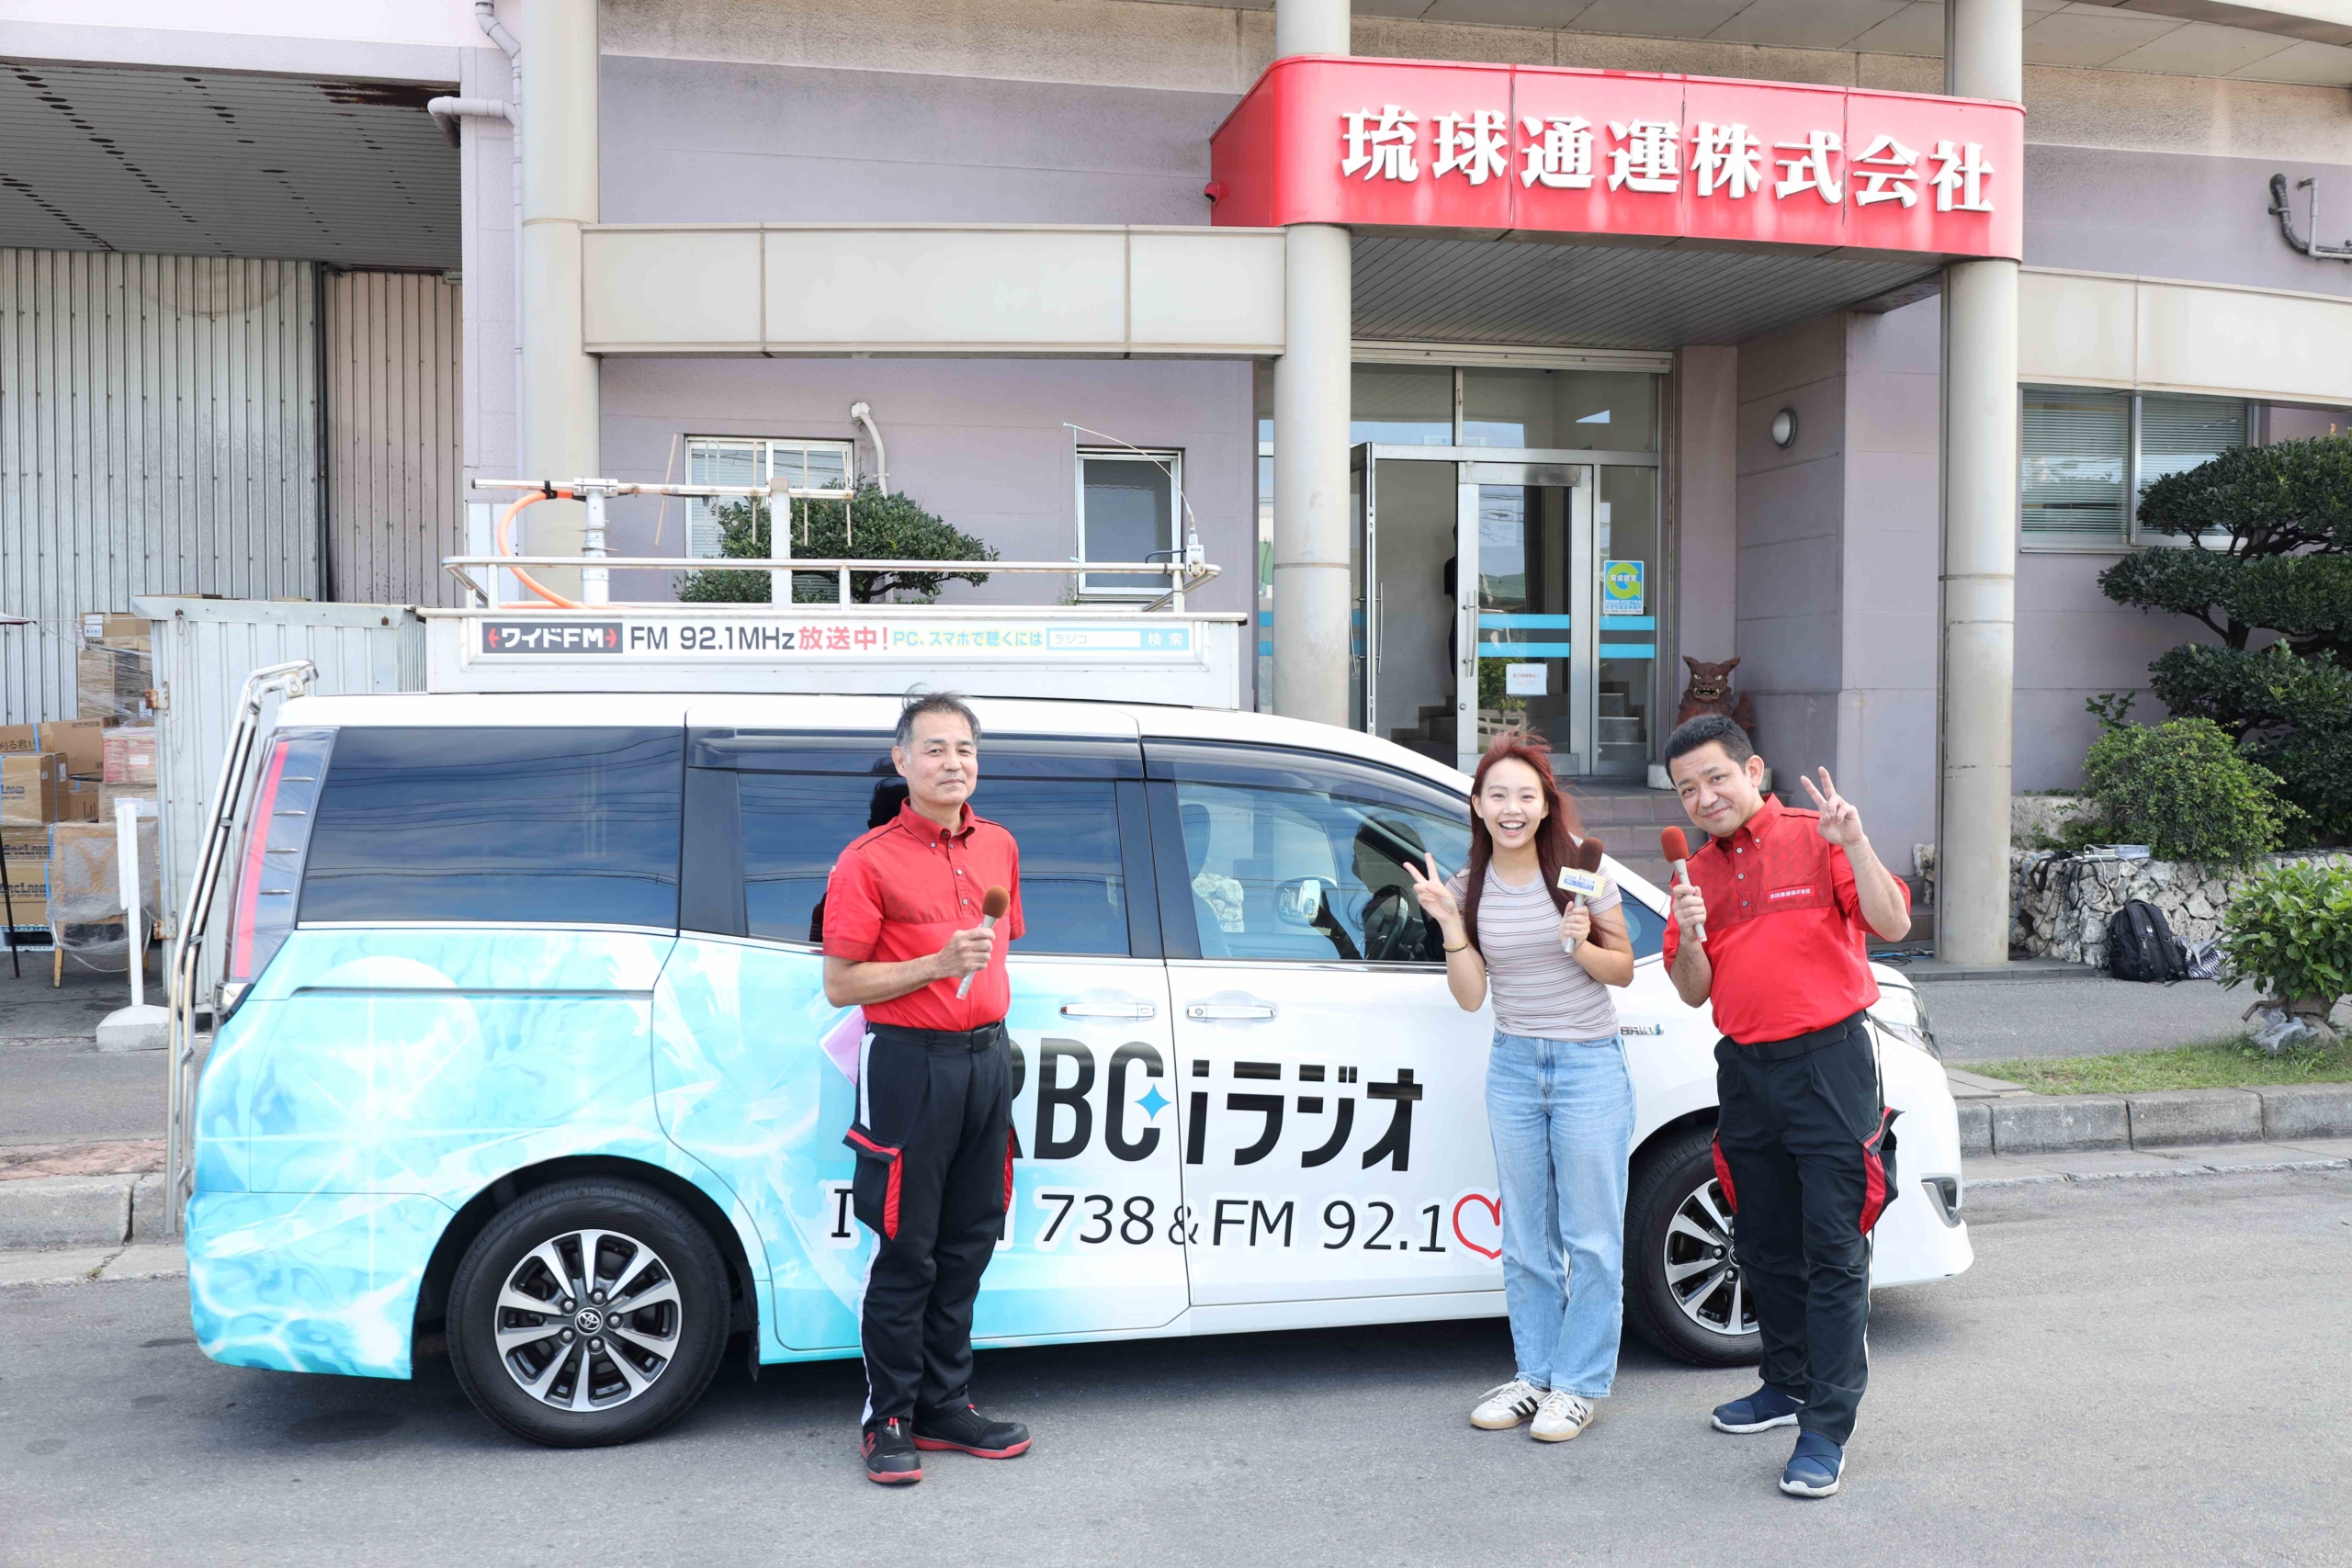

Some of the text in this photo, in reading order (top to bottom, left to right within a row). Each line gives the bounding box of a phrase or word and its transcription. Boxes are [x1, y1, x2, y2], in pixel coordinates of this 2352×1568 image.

[1341, 104, 1995, 213] 琉球通運株式会社
[502, 627, 605, 649] ワイドFM
[630, 626, 668, 650] FM
[680, 626, 795, 650] 92.1MHz
[1054, 634, 1088, 645] ラジコ
[1148, 632, 1183, 647] 検索
[1620, 1025, 1656, 1035] BRID
[1041, 1193, 1156, 1246] 738
[1213, 1199, 1295, 1247] FM
[1323, 1200, 1446, 1253] 92.1
